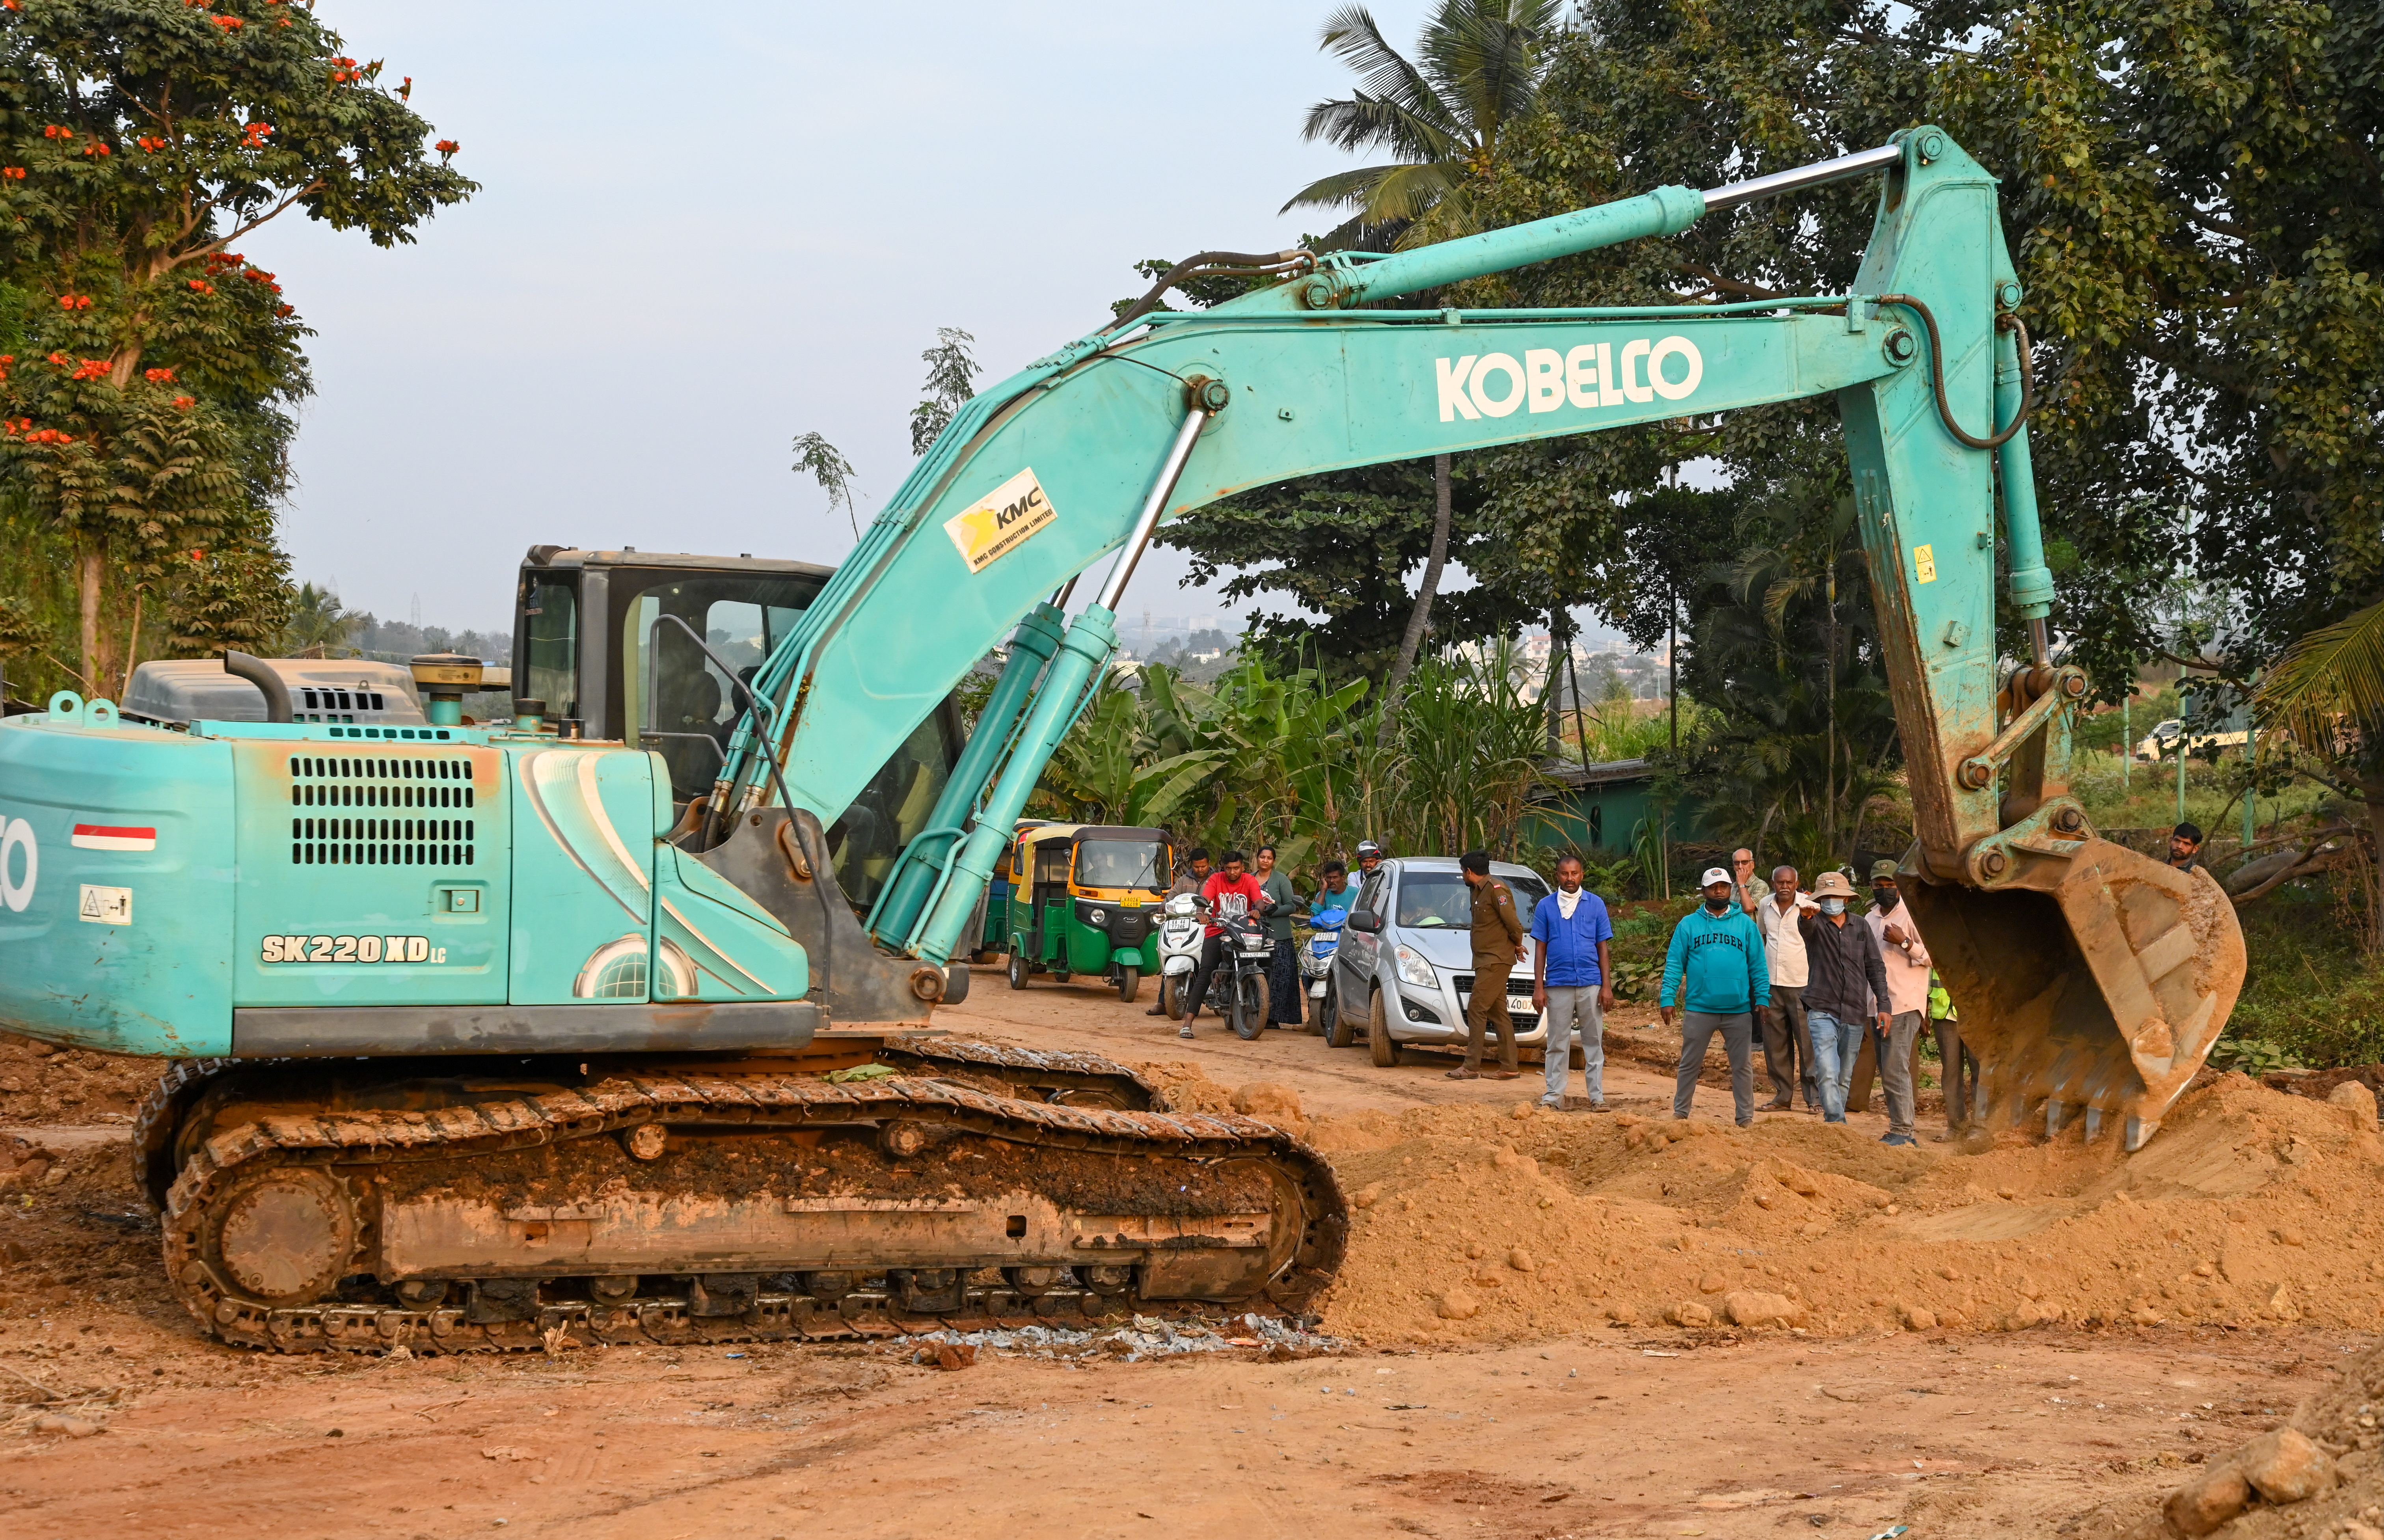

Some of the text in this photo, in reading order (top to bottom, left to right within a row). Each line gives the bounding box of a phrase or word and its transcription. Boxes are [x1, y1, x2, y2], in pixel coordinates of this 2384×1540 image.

[1436, 336, 1703, 422] KOBELCO
[996, 486, 1041, 530] KMC
[973, 508, 1053, 566] KMC CONSTRUCTION LIMITED
[262, 935, 446, 963] SK220XD LC
[1693, 933, 1743, 952] HILFIGER
